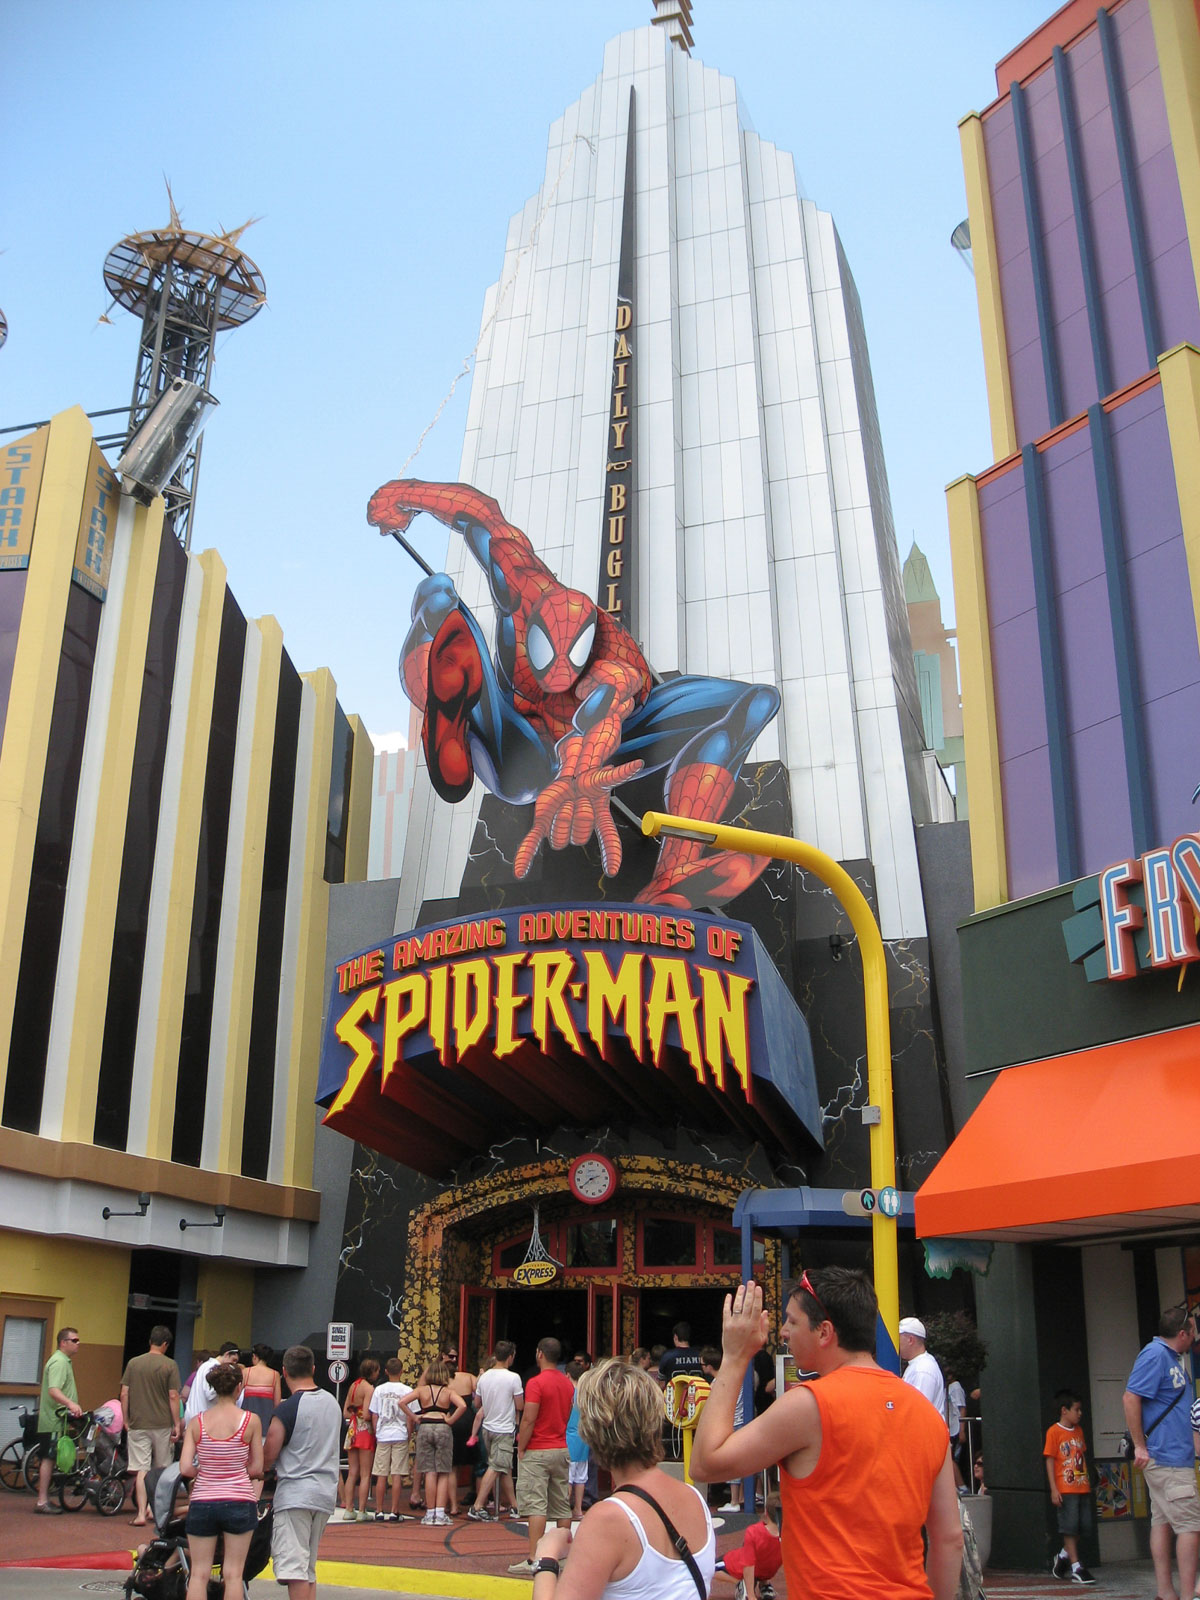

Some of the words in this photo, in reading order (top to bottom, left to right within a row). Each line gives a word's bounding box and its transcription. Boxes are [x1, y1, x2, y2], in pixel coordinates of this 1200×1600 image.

[611, 304, 632, 450] DAILY
[606, 483, 627, 621] BUGL
[336, 950, 384, 994] THE
[393, 916, 507, 971] AMAZING
[518, 910, 696, 950] ADVENTURES
[706, 925, 743, 963] OF
[321, 948, 756, 1125] SPIDER-MAN
[331, 1325, 347, 1335] SINGLE
[516, 1266, 555, 1285] EXPRESS
